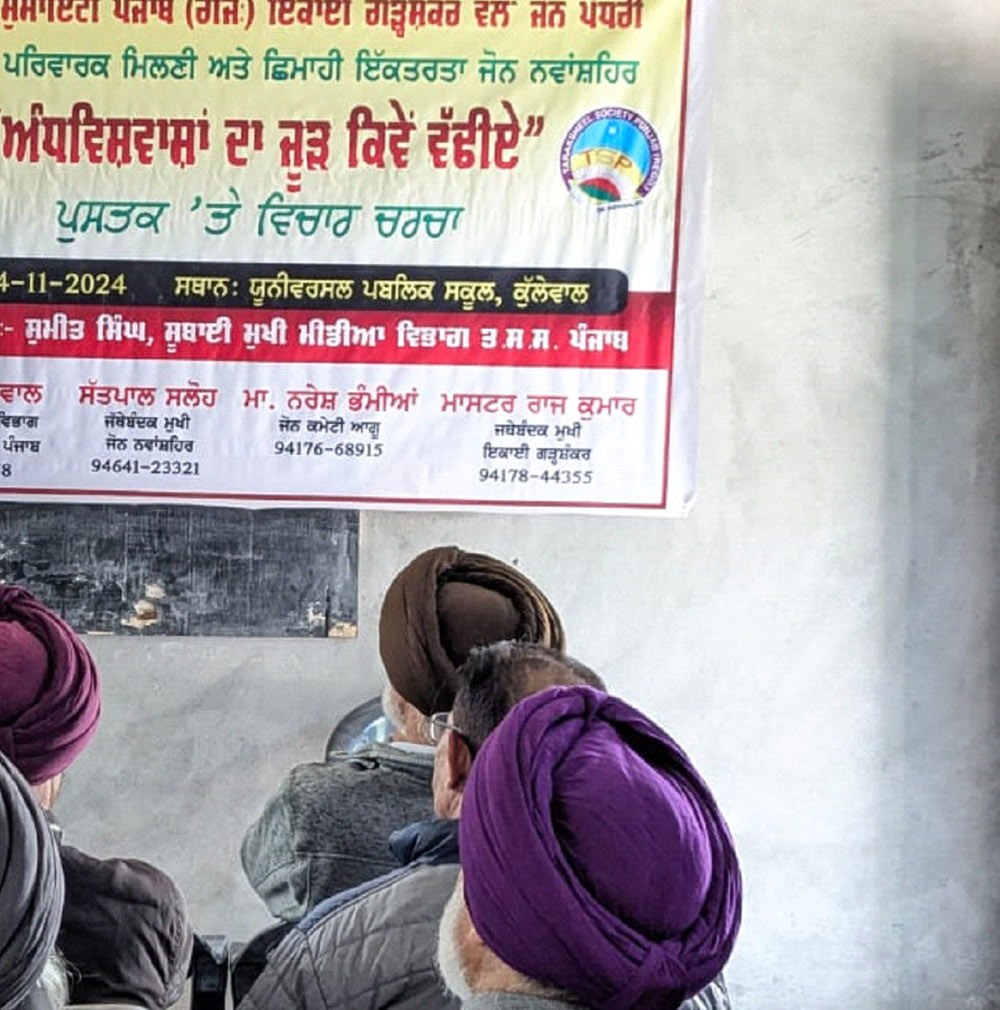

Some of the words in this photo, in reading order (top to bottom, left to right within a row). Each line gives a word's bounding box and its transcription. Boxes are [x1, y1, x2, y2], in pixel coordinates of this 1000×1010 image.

[114, 0, 174, 25] ਪਜਾਬ
[4, 44, 110, 79] ਪਰਿਵਾਰਕ
[122, 46, 198, 79] ਮਿਲਣੀ
[209, 47, 251, 80] ਅਤੇ
[264, 47, 343, 81] ਛਿਮਾਹੀ
[356, 48, 468, 83] ਇੱਕਤਰਤਾ
[225, 119, 263, 166] ਦਾ
[278, 119, 330, 192] ਜੂੜ
[347, 99, 416, 168] ਕਿਵੇਂ
[56, 200, 169, 243] ਪੁਸਤਕ
[257, 191, 362, 237] ਵਿਚਾਰ
[375, 204, 465, 238] ਚਰਚਾ
[174, 275, 239, 298] ਸਥਾਨ:
[249, 271, 354, 306] ਯੂਨੀਵਰਸਲ
[363, 273, 435, 300] ਪਬਲਿਕ
[444, 279, 503, 310] ਸਕੂਲ,
[513, 274, 589, 307] ਕੁੱਲੇਵਾਲ
[25, 313, 85, 345] ਸੁਮੀਤ
[96, 313, 153, 347] ਸਿੰਘ,
[164, 316, 231, 352] ਸੂਬਾਈ
[243, 317, 287, 350] ਮੁਖੀ
[298, 318, 386, 347] ਮੀਡੀਆ
[397, 320, 469, 349] ਵਿਭਾਗ
[569, 324, 628, 352] ਪੰਜਾਬ
[79, 379, 156, 406] ਸੱਤਪਾਲ
[166, 380, 218, 408] ਸਲੋਹ
[243, 389, 275, 410] ਮਾ.
[441, 393, 517, 413] ਮਾਸਟਰ
[527, 395, 567, 415] ਰਾਜ
[578, 397, 637, 421] ਕੁਮਾਰ
[164, 413, 191, 433] ਮੁਖੀ
[306, 416, 345, 433] ਕਮੇਟੀ
[555, 422, 582, 441] ਮੁਖੀ
[3, 435, 41, 453] ਪੰਜਾਬ
[274, 441, 383, 457] 94176-68915
[483, 442, 530, 459] ਇਕਾਈ
[91, 458, 200, 475] 94641-23321
[479, 468, 593, 484] 94178-44355
